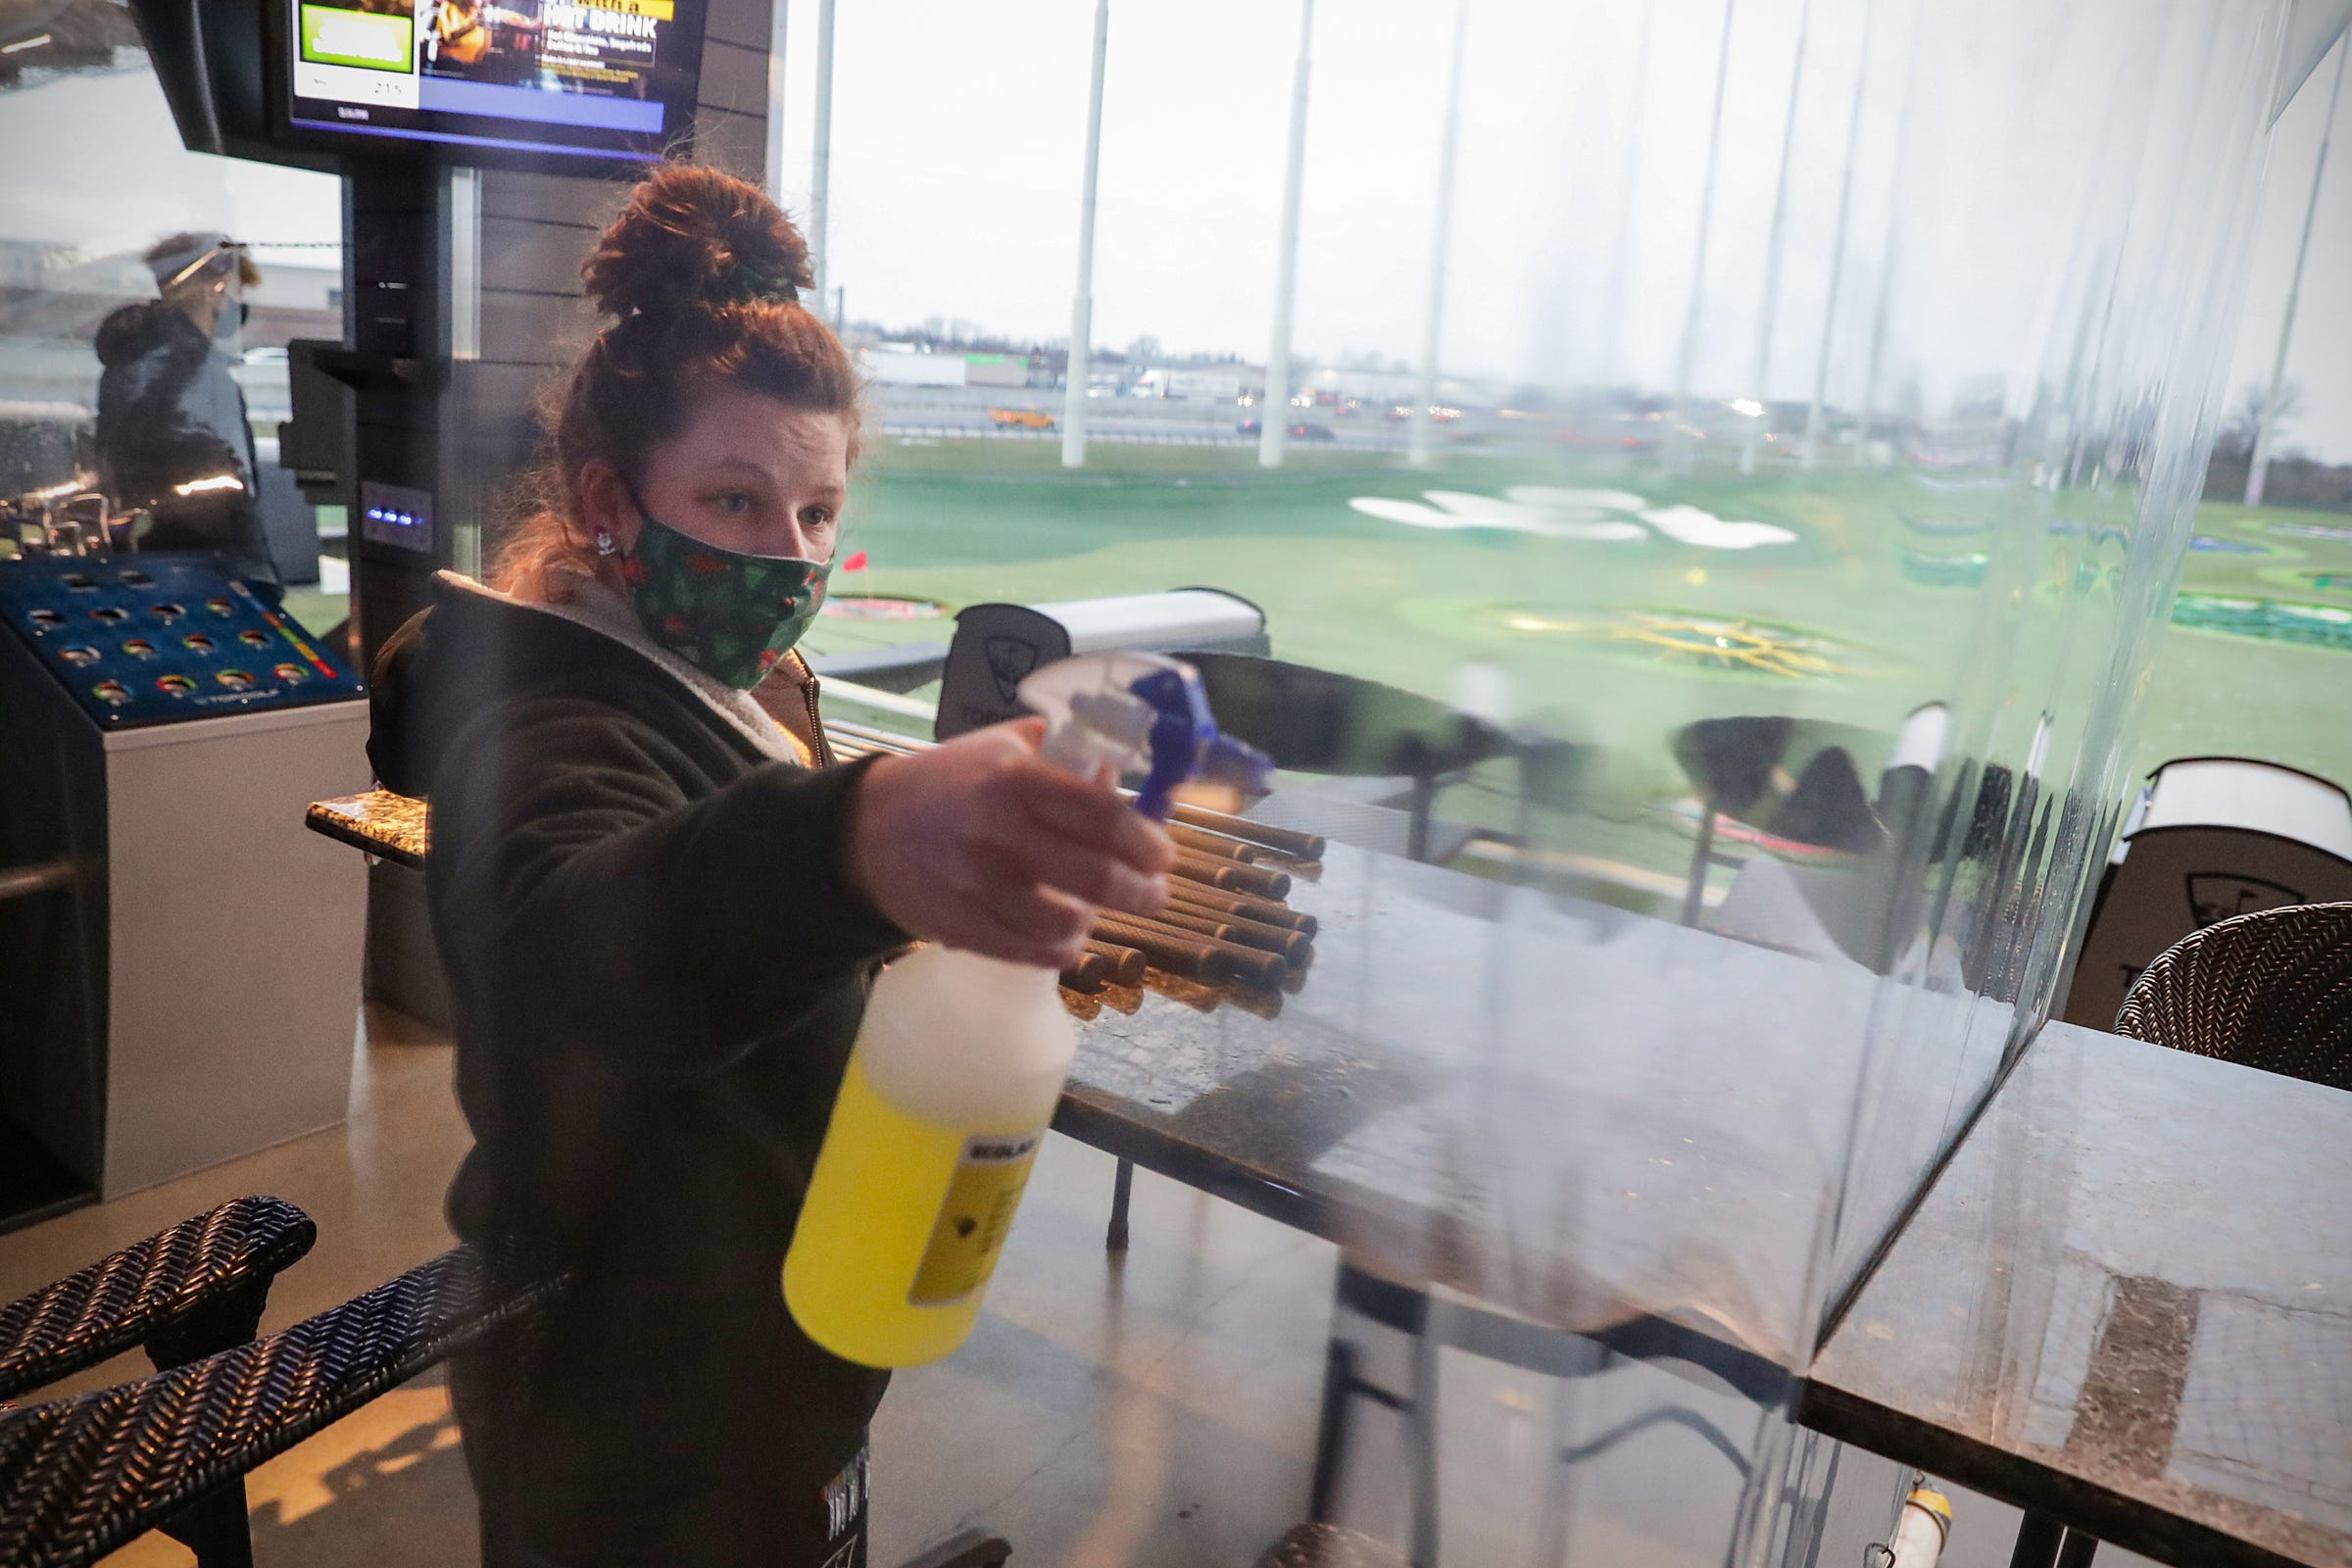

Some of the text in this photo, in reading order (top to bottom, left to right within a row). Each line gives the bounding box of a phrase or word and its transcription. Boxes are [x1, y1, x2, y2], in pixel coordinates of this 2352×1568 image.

[628, 2, 640, 14] a
[543, 2, 659, 39] HOT DRINK
